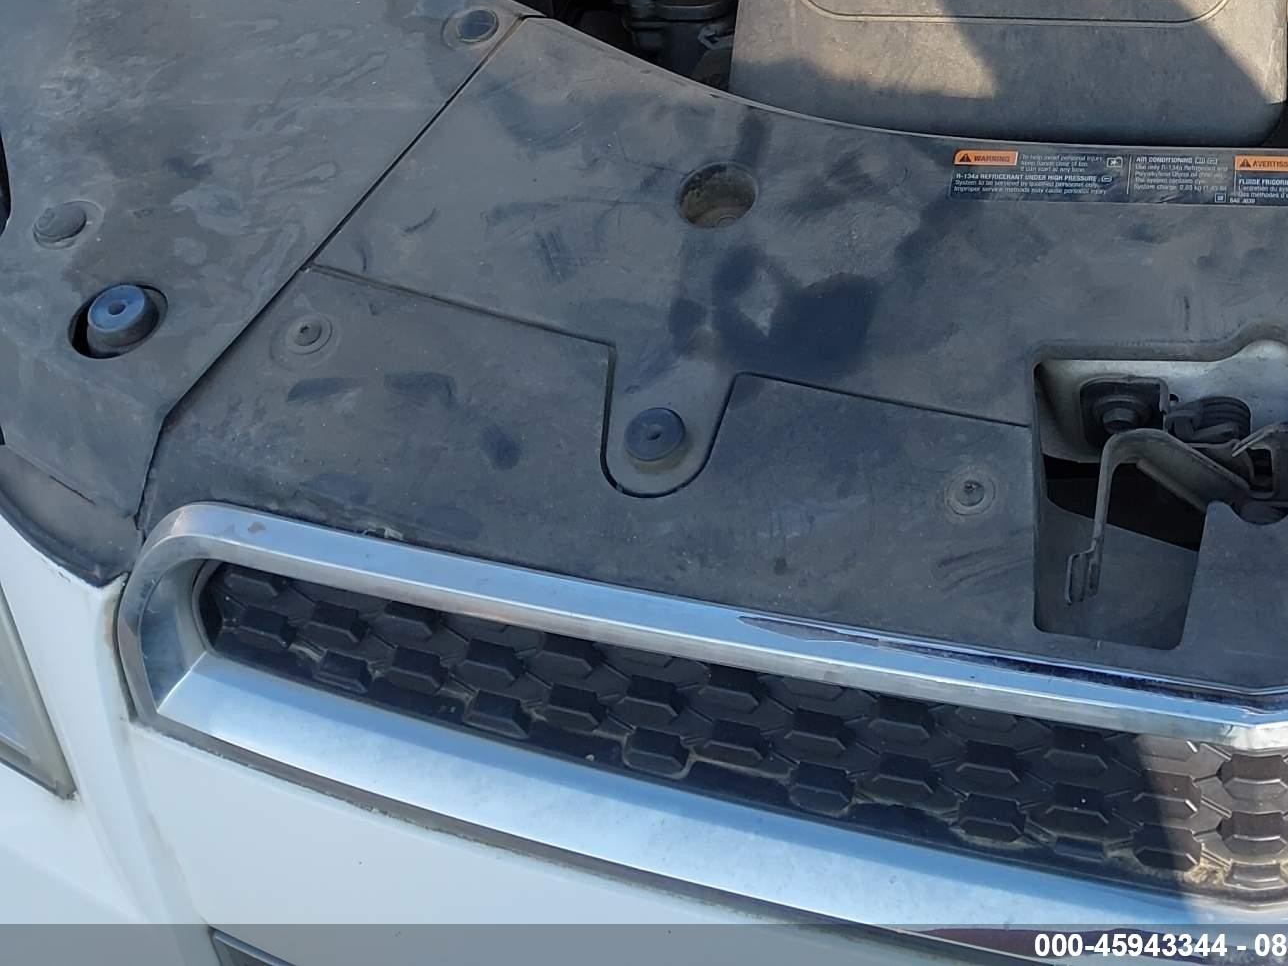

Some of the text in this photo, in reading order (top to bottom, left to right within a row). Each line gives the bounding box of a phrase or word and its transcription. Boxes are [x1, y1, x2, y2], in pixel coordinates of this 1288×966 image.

[974, 155, 1010, 163] WARNING
[1148, 156, 1193, 164] CONDITIONING
[980, 173, 1023, 182] REFRIGERANT
[1025, 174, 1046, 182] UNDER
[1064, 175, 1098, 183] PRESSURE
[954, 186, 980, 194] Improper
